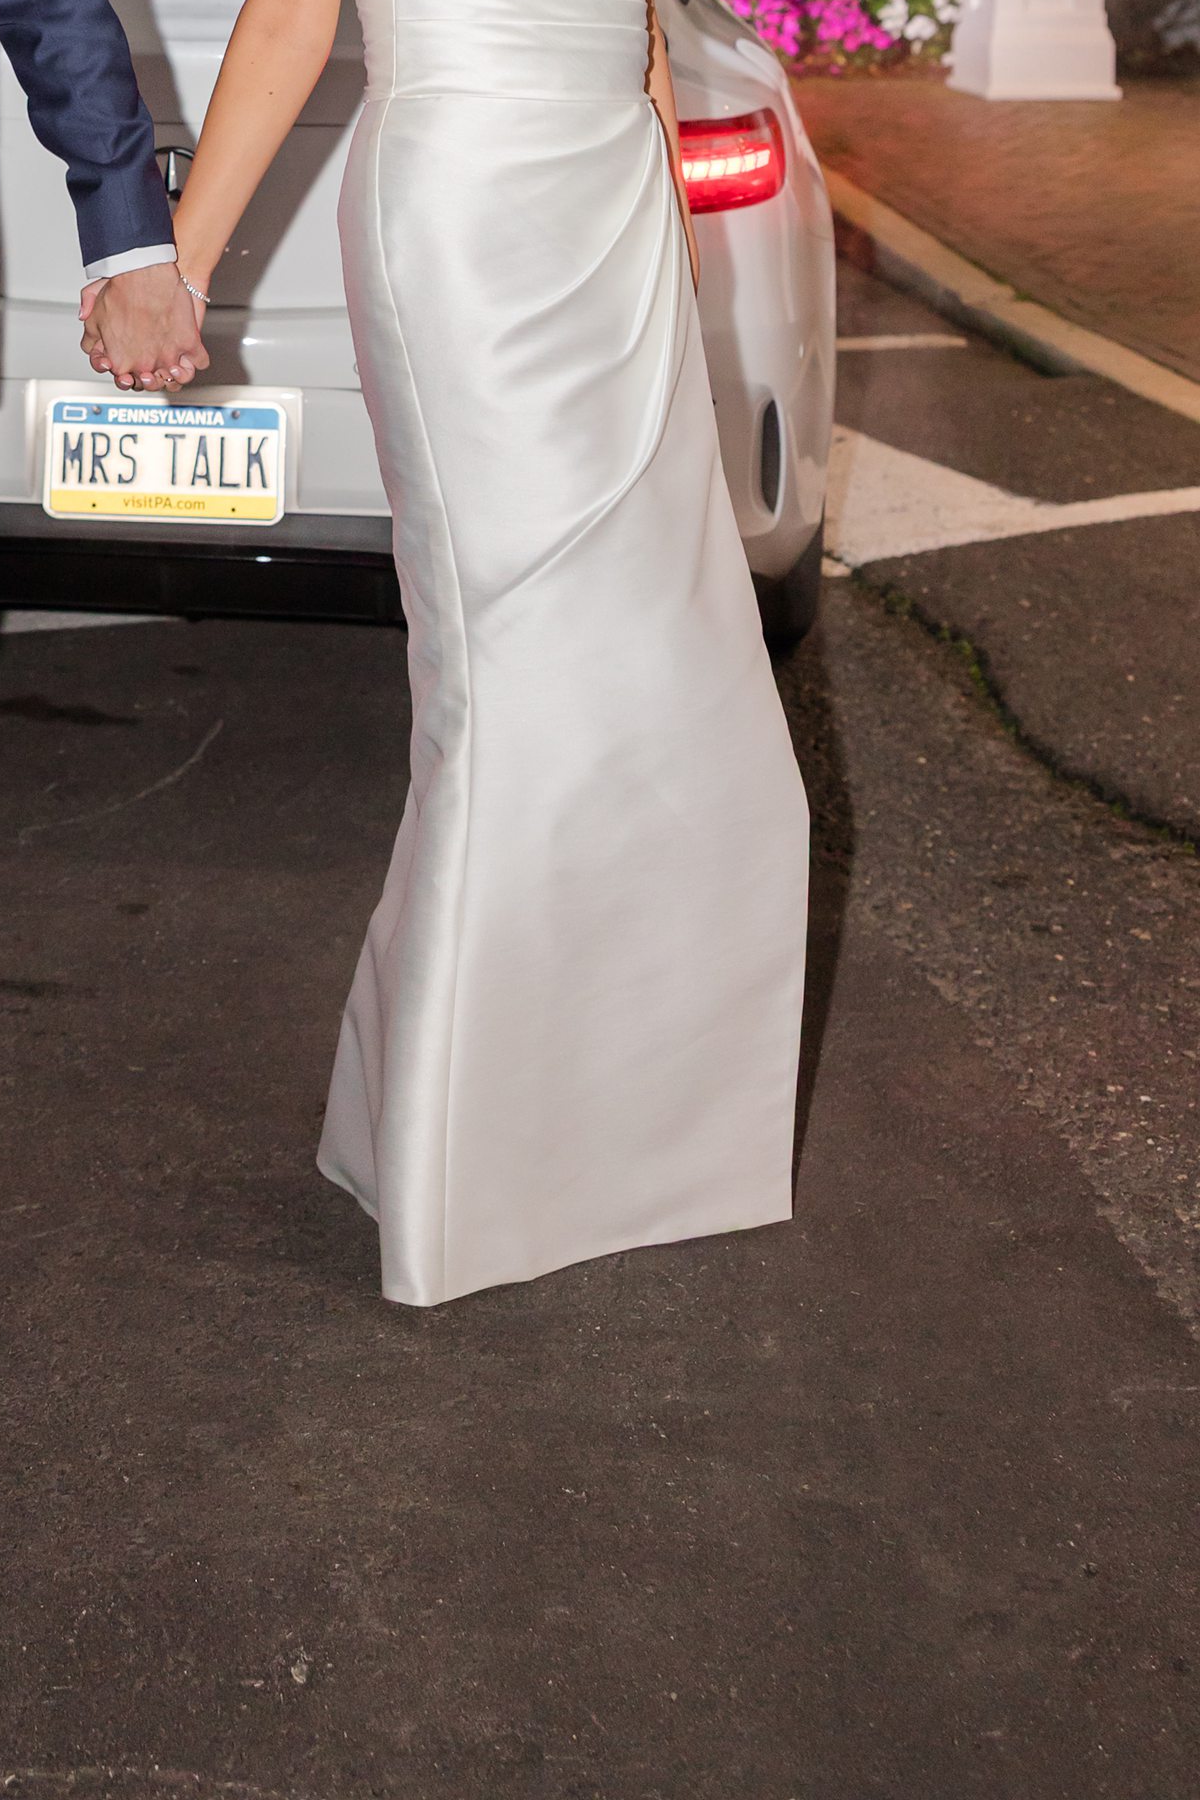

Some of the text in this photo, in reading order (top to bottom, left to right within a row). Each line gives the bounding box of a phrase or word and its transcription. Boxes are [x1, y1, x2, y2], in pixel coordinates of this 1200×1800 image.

[108, 408, 224, 426] PENNSYLVANIA
[62, 431, 269, 489] MRS TALK
[123, 496, 206, 511] visitPA.com
